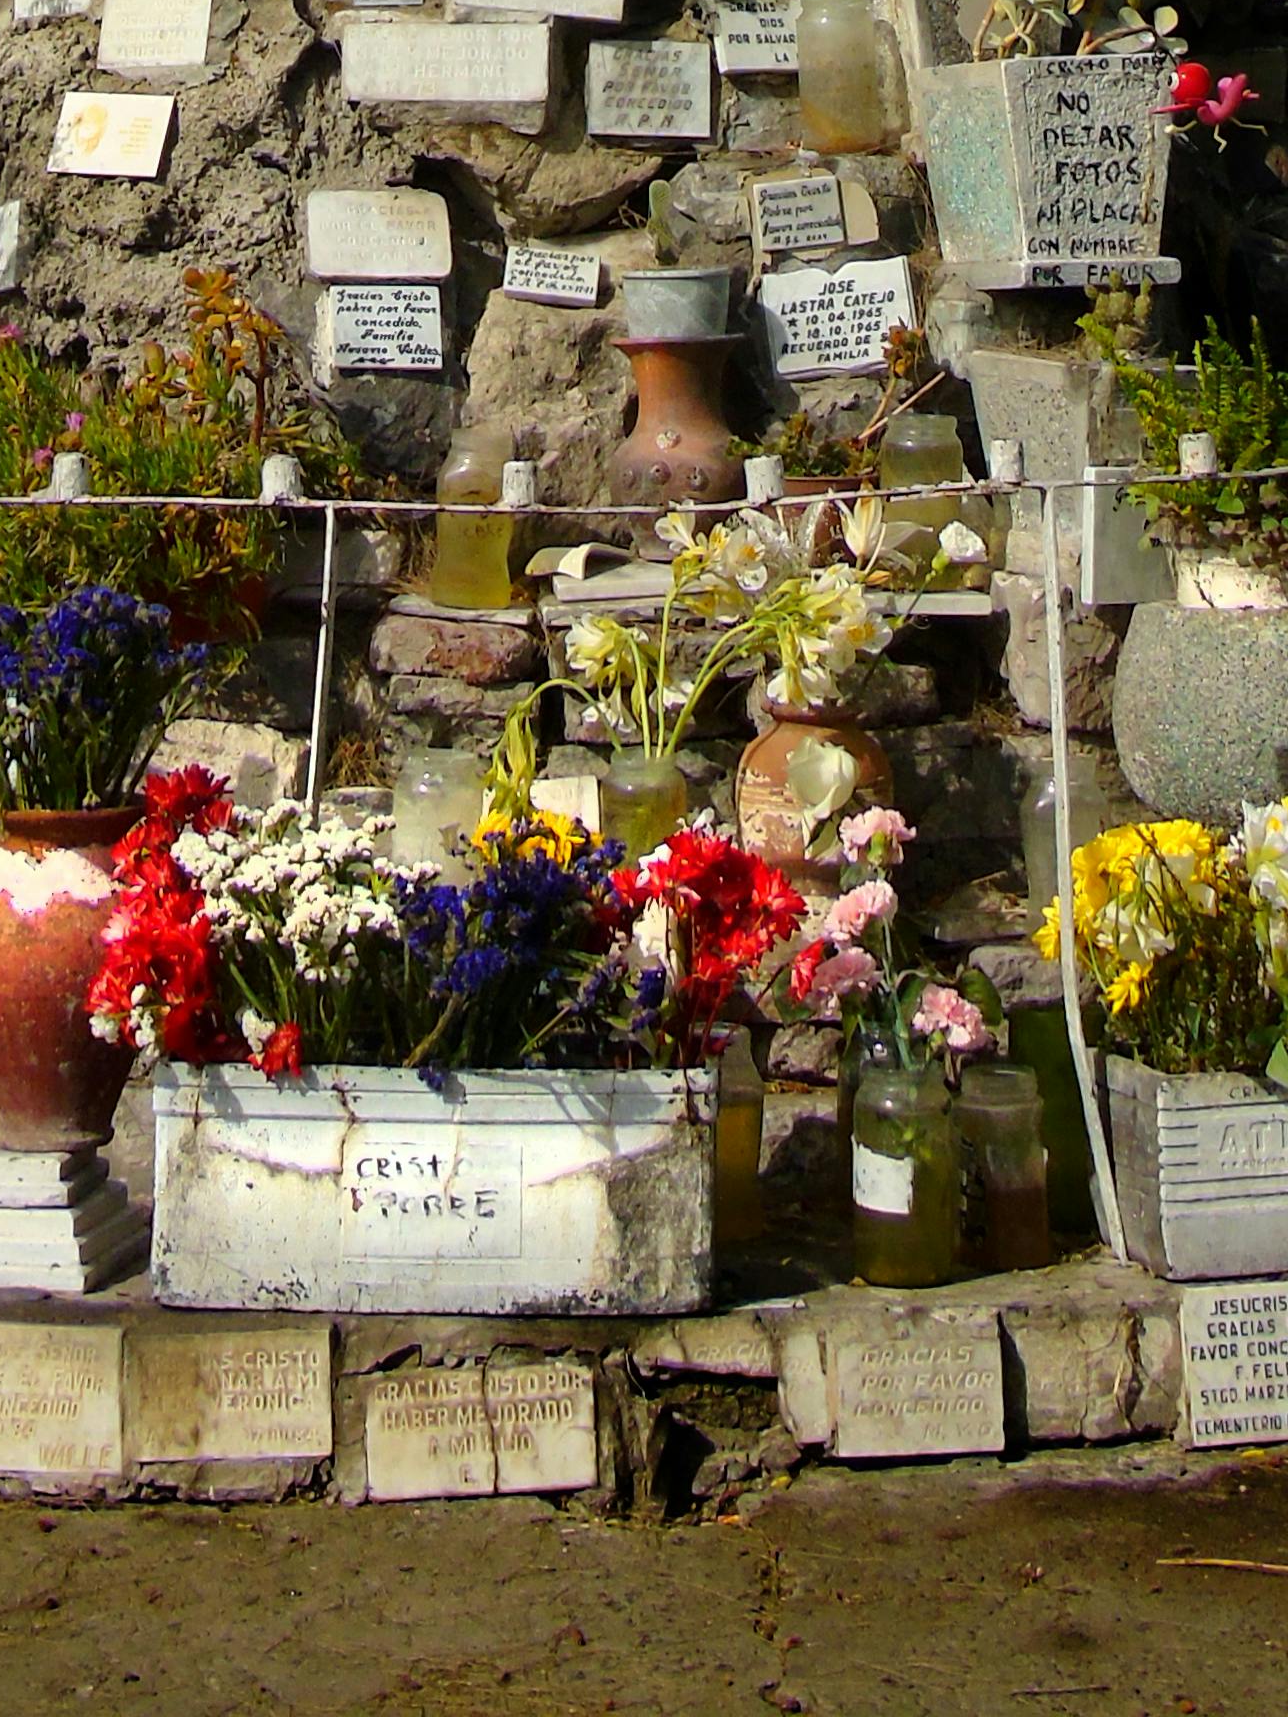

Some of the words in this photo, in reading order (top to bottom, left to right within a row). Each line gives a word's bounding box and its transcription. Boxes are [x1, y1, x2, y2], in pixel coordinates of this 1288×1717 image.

[729, 2, 777, 13] GRACIAS
[760, 17, 784, 28] DIOS
[728, 33, 750, 44] POR
[755, 32, 796, 45] SALVAR
[425, 45, 529, 60] MEJORADO
[613, 46, 682, 62] GRACIAS
[775, 52, 790, 63] LA
[1046, 59, 1110, 75] CRISTO
[602, 80, 634, 93] POR
[641, 83, 691, 95] FAVOR
[604, 97, 693, 111] CONCEDIDO
[1057, 91, 1090, 115] NO
[1042, 124, 1135, 151] DEJAR
[1055, 157, 1142, 186] FOTOS
[1037, 197, 1062, 227] NI
[1070, 197, 1158, 225] PLACAS
[386, 219, 437, 231] FAVOR
[1028, 236, 1060, 255] CON
[1070, 237, 1139, 259] NOMBRE
[1032, 265, 1065, 285] POR
[1086, 265, 1155, 285] FAVOR
[337, 289, 384, 303] Gracias
[391, 290, 431, 301] Cristo
[818, 279, 856, 296] JOSE
[337, 302, 372, 315] pobre
[376, 304, 399, 315] por
[403, 302, 437, 313] favor
[780, 298, 835, 315] LASTRA
[843, 290, 895, 307] CATEJO
[360, 329, 414, 341] Familia
[781, 337, 849, 355] RECUERDO
[855, 335, 872, 346] DE
[410, 356, 436, 365] 2024
[817, 348, 870, 364] FAMILIA
[373, 1190, 499, 1220] POBRE
[1207, 1319, 1276, 1339] GRACIAS
[242, 1351, 320, 1369] CRISTO
[862, 1345, 973, 1366] GRACIAS
[1190, 1343, 1239, 1362] FAVOR
[374, 1376, 461, 1406] GRACIAS
[468, 1373, 538, 1396] CRISTO
[545, 1371, 585, 1393] POR
[862, 1372, 905, 1393] POR
[912, 1370, 996, 1392] FAVOR
[383, 1407, 449, 1433] HABER
[456, 1397, 573, 1429] MEJORADO
[1195, 1417, 1282, 1436] CEMENTERIO
